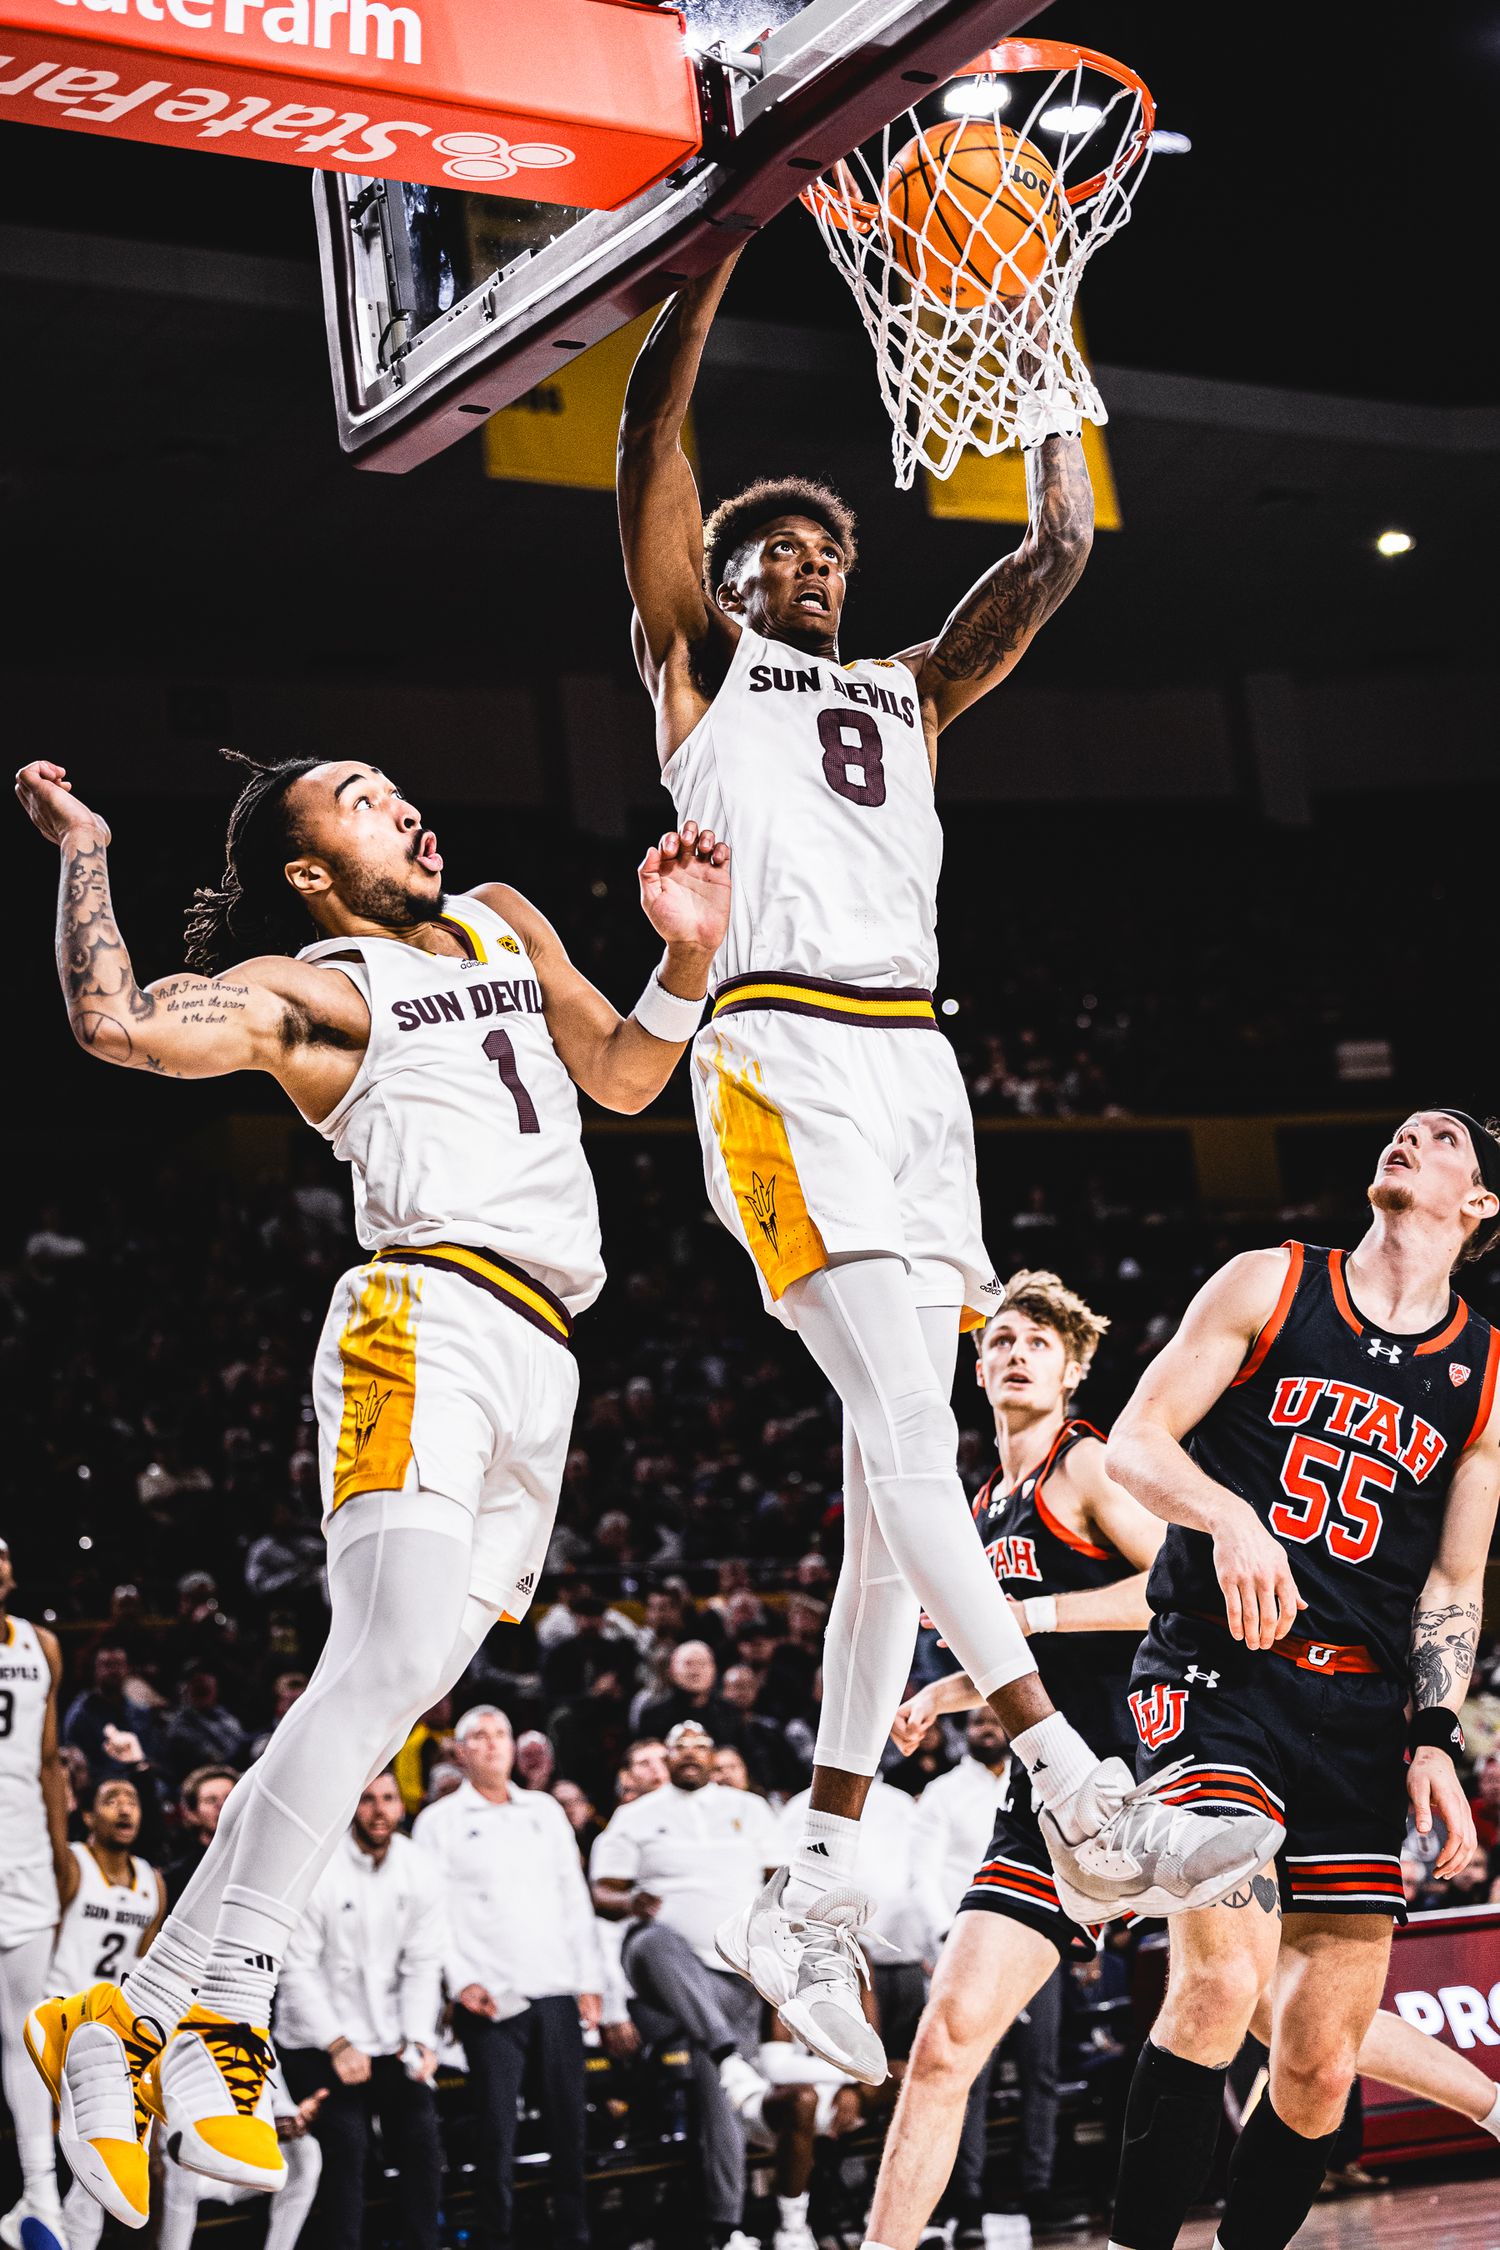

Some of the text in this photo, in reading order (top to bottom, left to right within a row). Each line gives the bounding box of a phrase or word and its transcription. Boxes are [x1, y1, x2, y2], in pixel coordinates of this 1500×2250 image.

[749, 665, 915, 729] SUN DEVILS
[817, 708, 887, 808] 8
[208, 996, 221, 1008] the
[211, 982, 250, 996] through
[391, 979, 544, 1032] SUN DEVIL
[482, 1028, 541, 1134] 1
[1267, 1376, 1448, 1486] UTAH
[1268, 1432, 1398, 1565] 55
[984, 1535, 1043, 1582] AH
[94, 1932, 127, 1978] 2
[1393, 1981, 1500, 2049] PR
